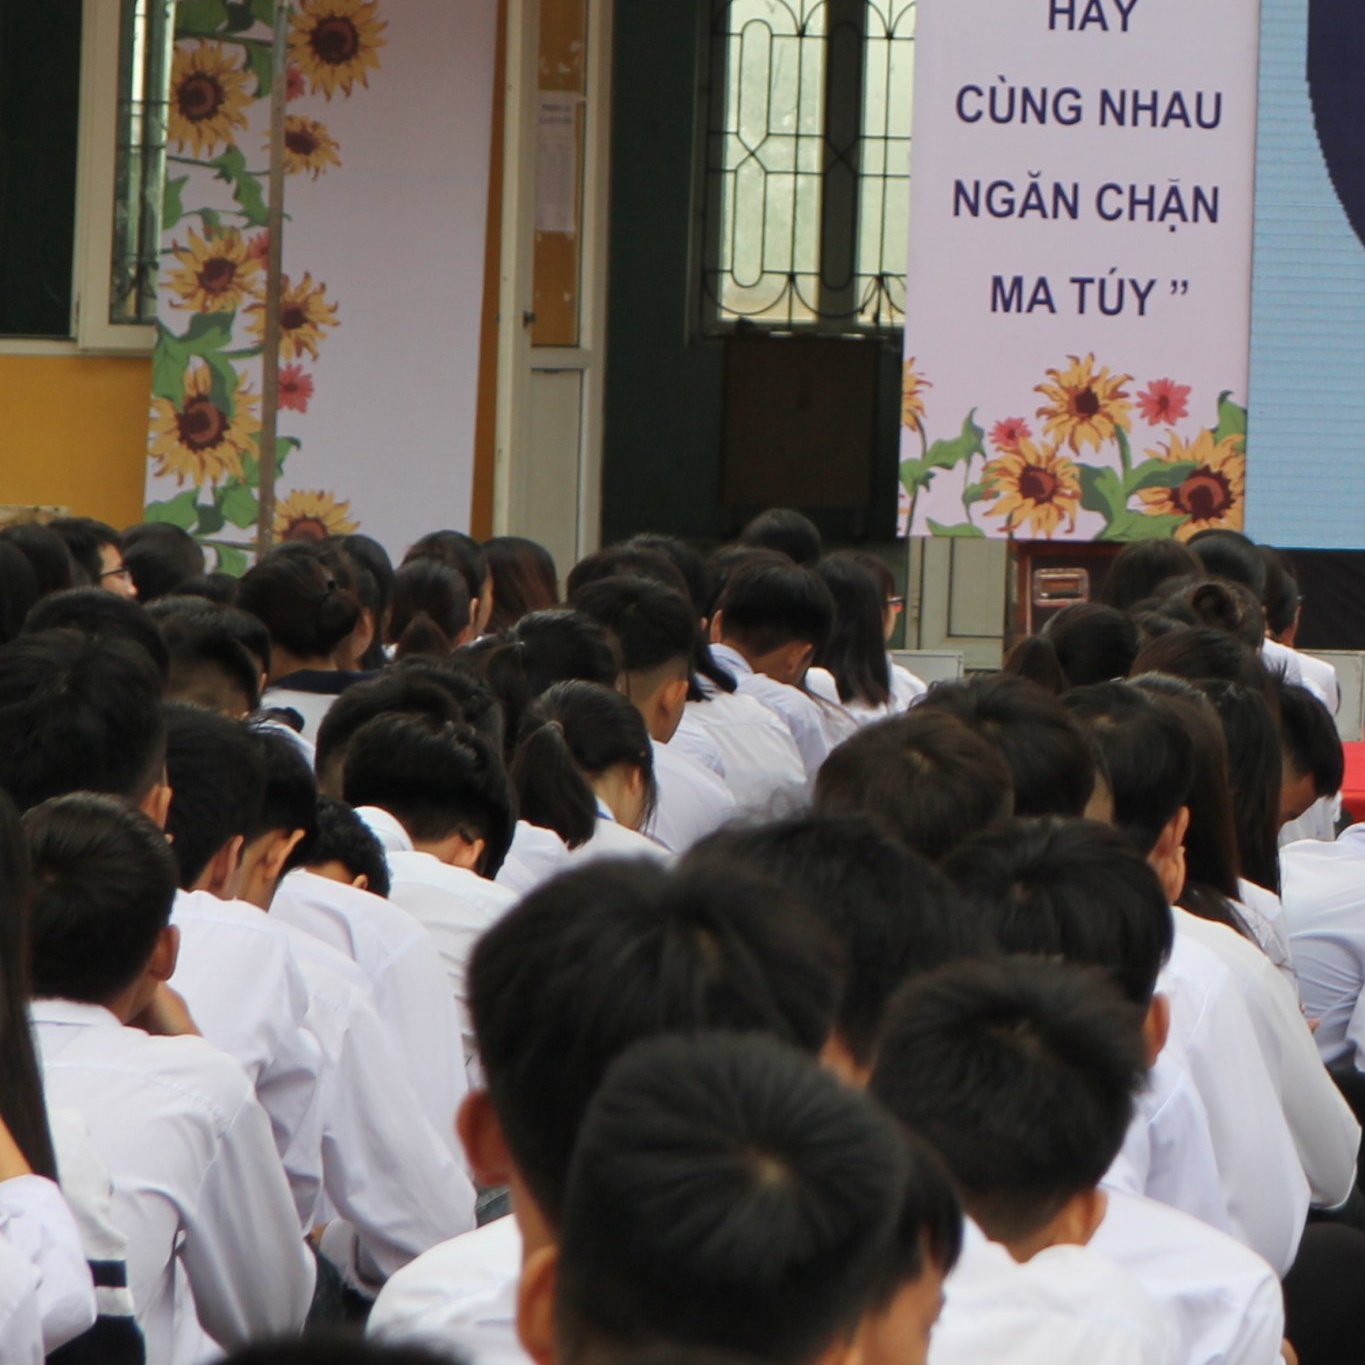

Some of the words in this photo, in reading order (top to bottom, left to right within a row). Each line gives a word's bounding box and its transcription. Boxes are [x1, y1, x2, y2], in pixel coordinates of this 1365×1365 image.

[956, 76, 1082, 125] CÙNG
[1100, 89, 1221, 129] NHAU
[954, 172, 1078, 219] NGĂN
[1096, 176, 1218, 232] CHẶN
[991, 276, 1056, 313] MA
[1070, 268, 1156, 316] TÚY
